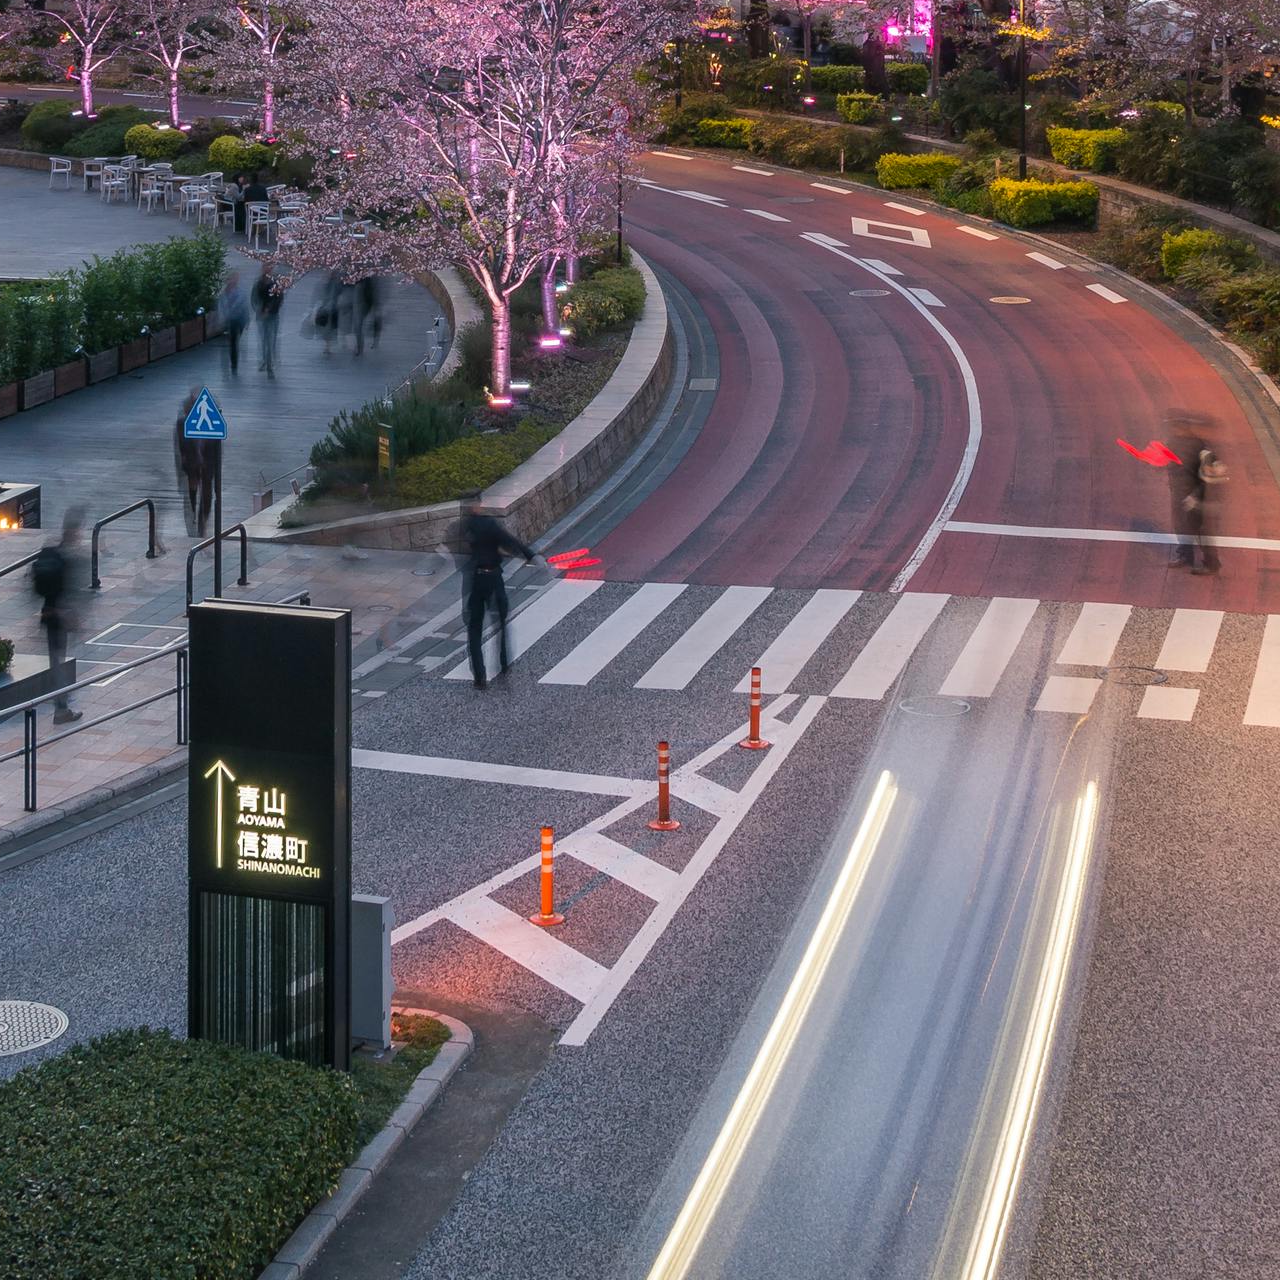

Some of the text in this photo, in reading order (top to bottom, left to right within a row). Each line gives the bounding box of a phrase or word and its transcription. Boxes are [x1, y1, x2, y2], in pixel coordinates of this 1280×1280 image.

[237, 785, 286, 816] 青山
[237, 813, 286, 829] AOYAMA
[237, 830, 308, 864] 信濃町
[237, 858, 320, 879] SHINANOMACHI
